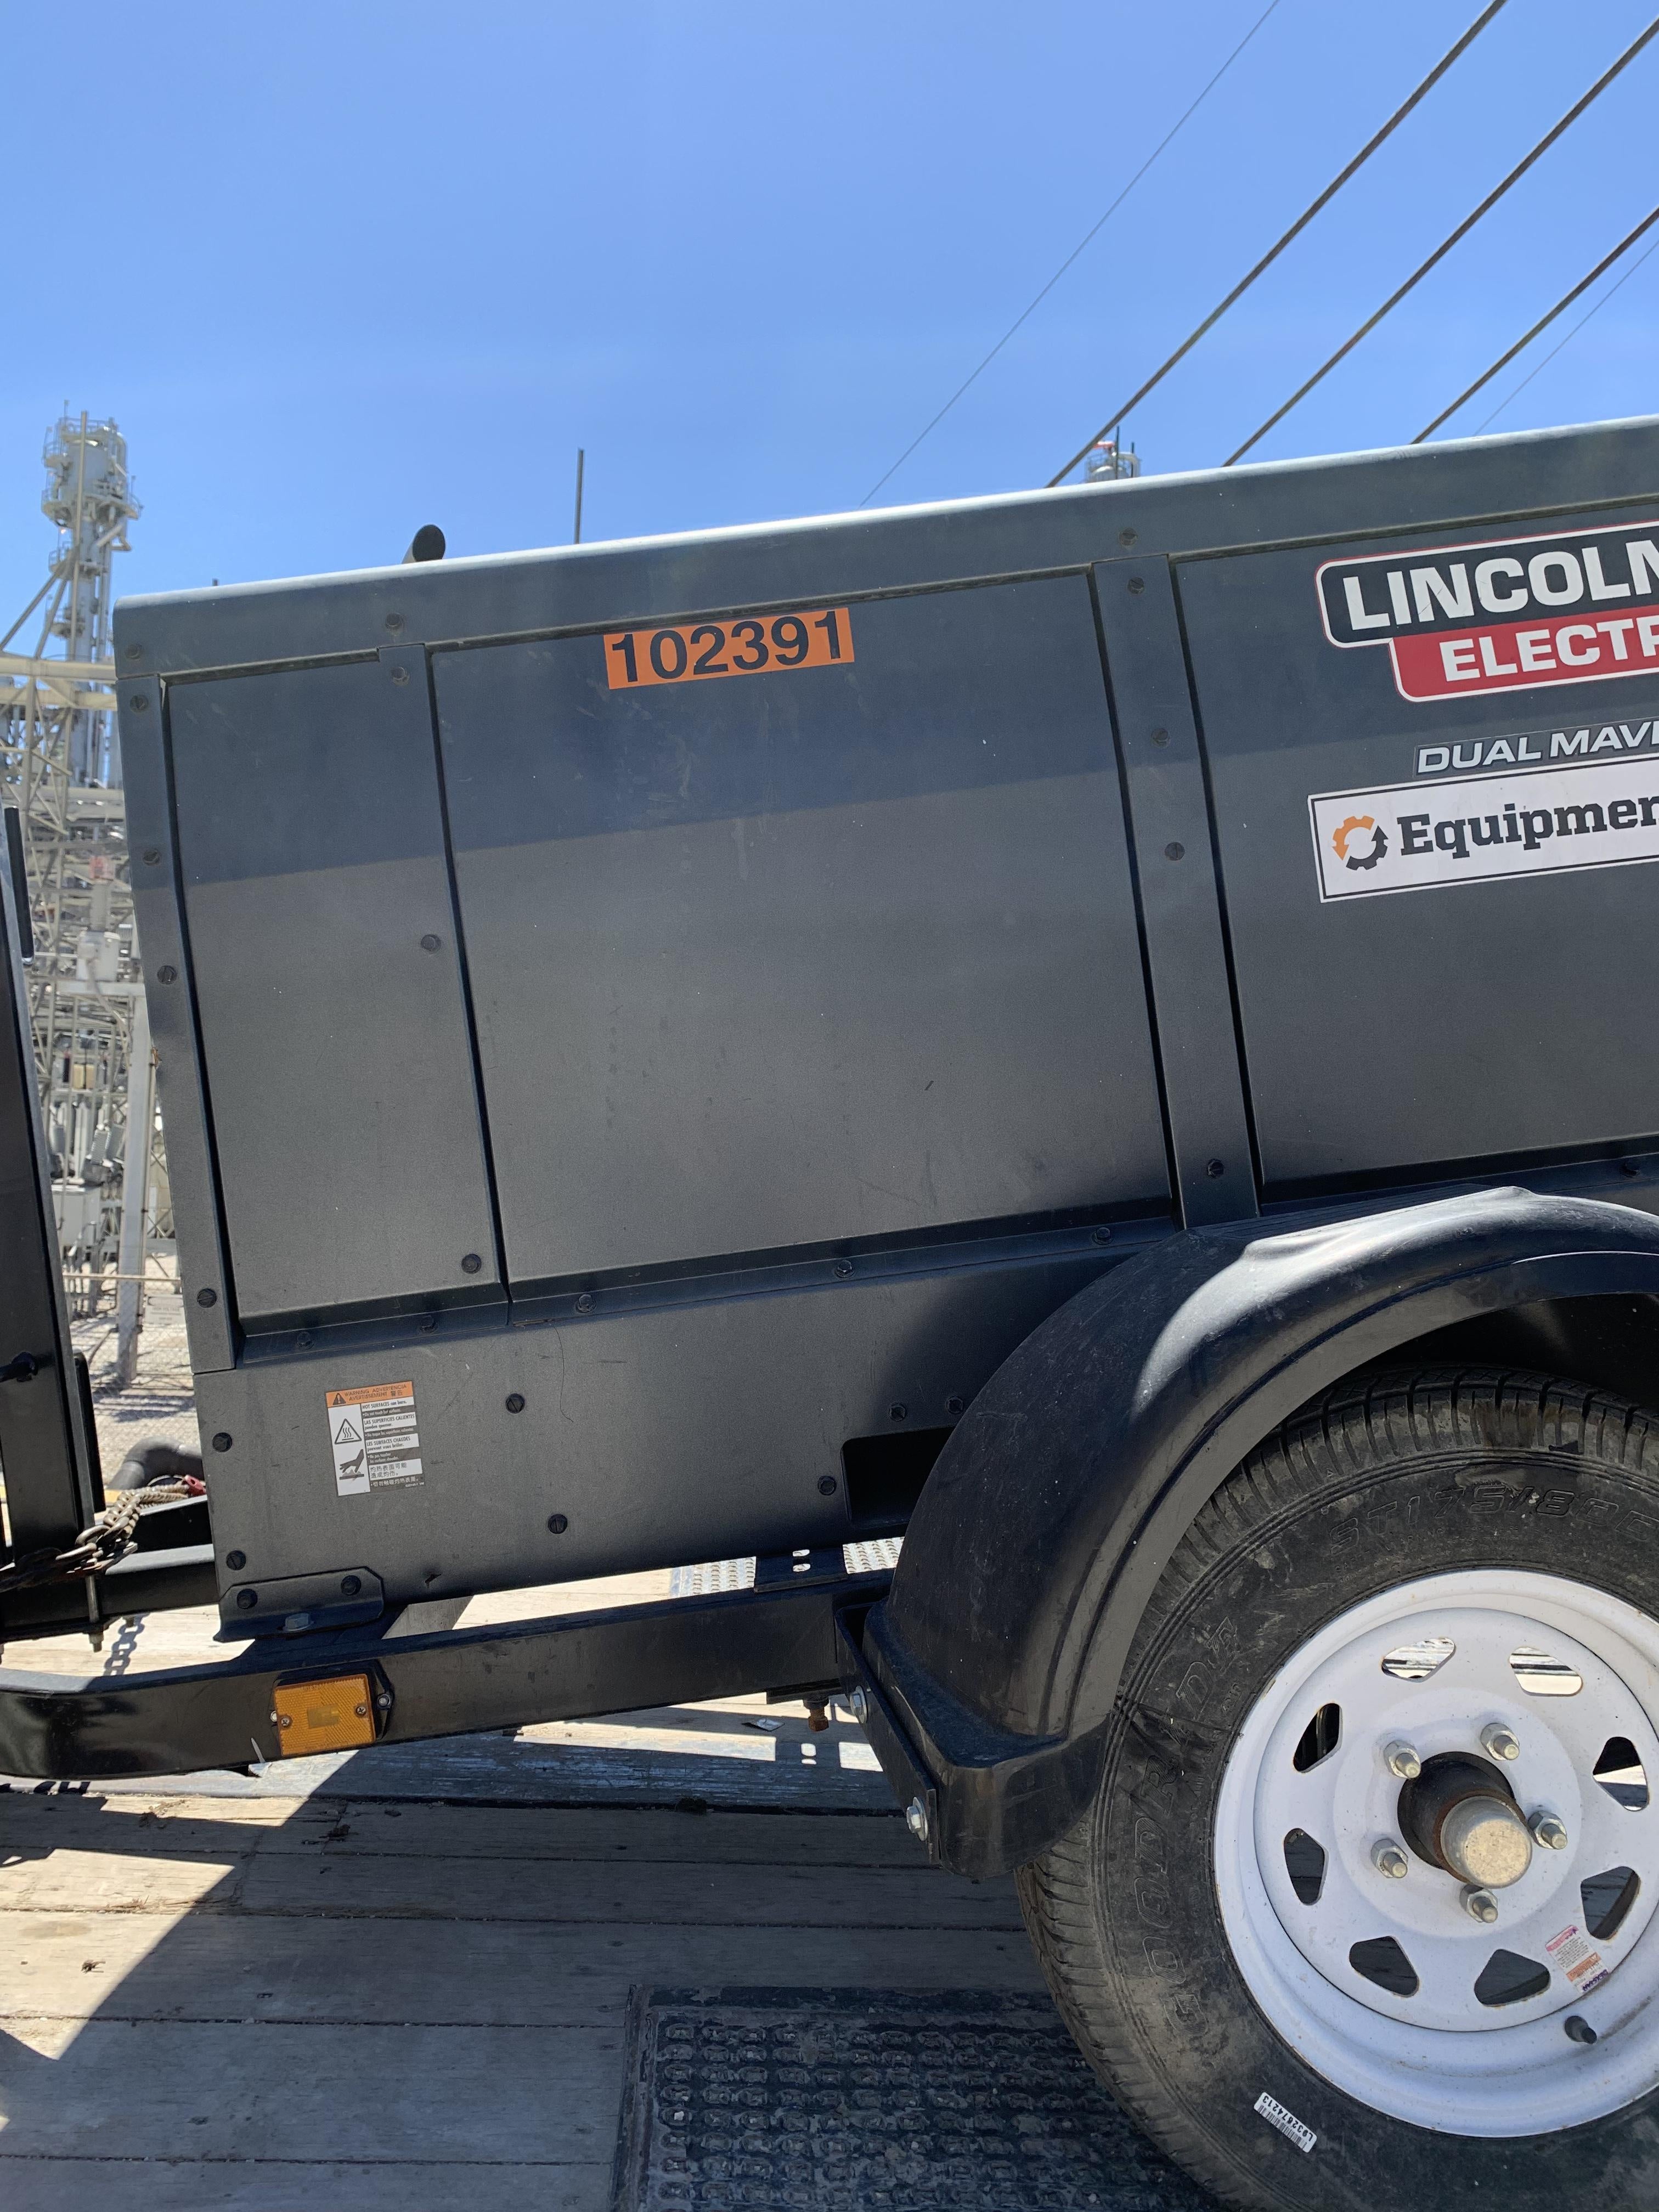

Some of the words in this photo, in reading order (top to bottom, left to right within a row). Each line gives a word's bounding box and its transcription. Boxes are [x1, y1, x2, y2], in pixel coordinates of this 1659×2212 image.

[612, 610, 841, 682] 102391
[1417, 738, 1541, 774] DUAL
[1549, 718, 1659, 758] MAV
[344, 1389, 369, 1397] WARNING
[372, 1384, 407, 1393] ADVERTENCIA
[349, 1392, 387, 1401] AVERTISSEMENT
[371, 1416, 395, 1424] SUPERFICIES
[396, 1413, 415, 1421] CALIENTES
[374, 1438, 393, 1446] SURFACES
